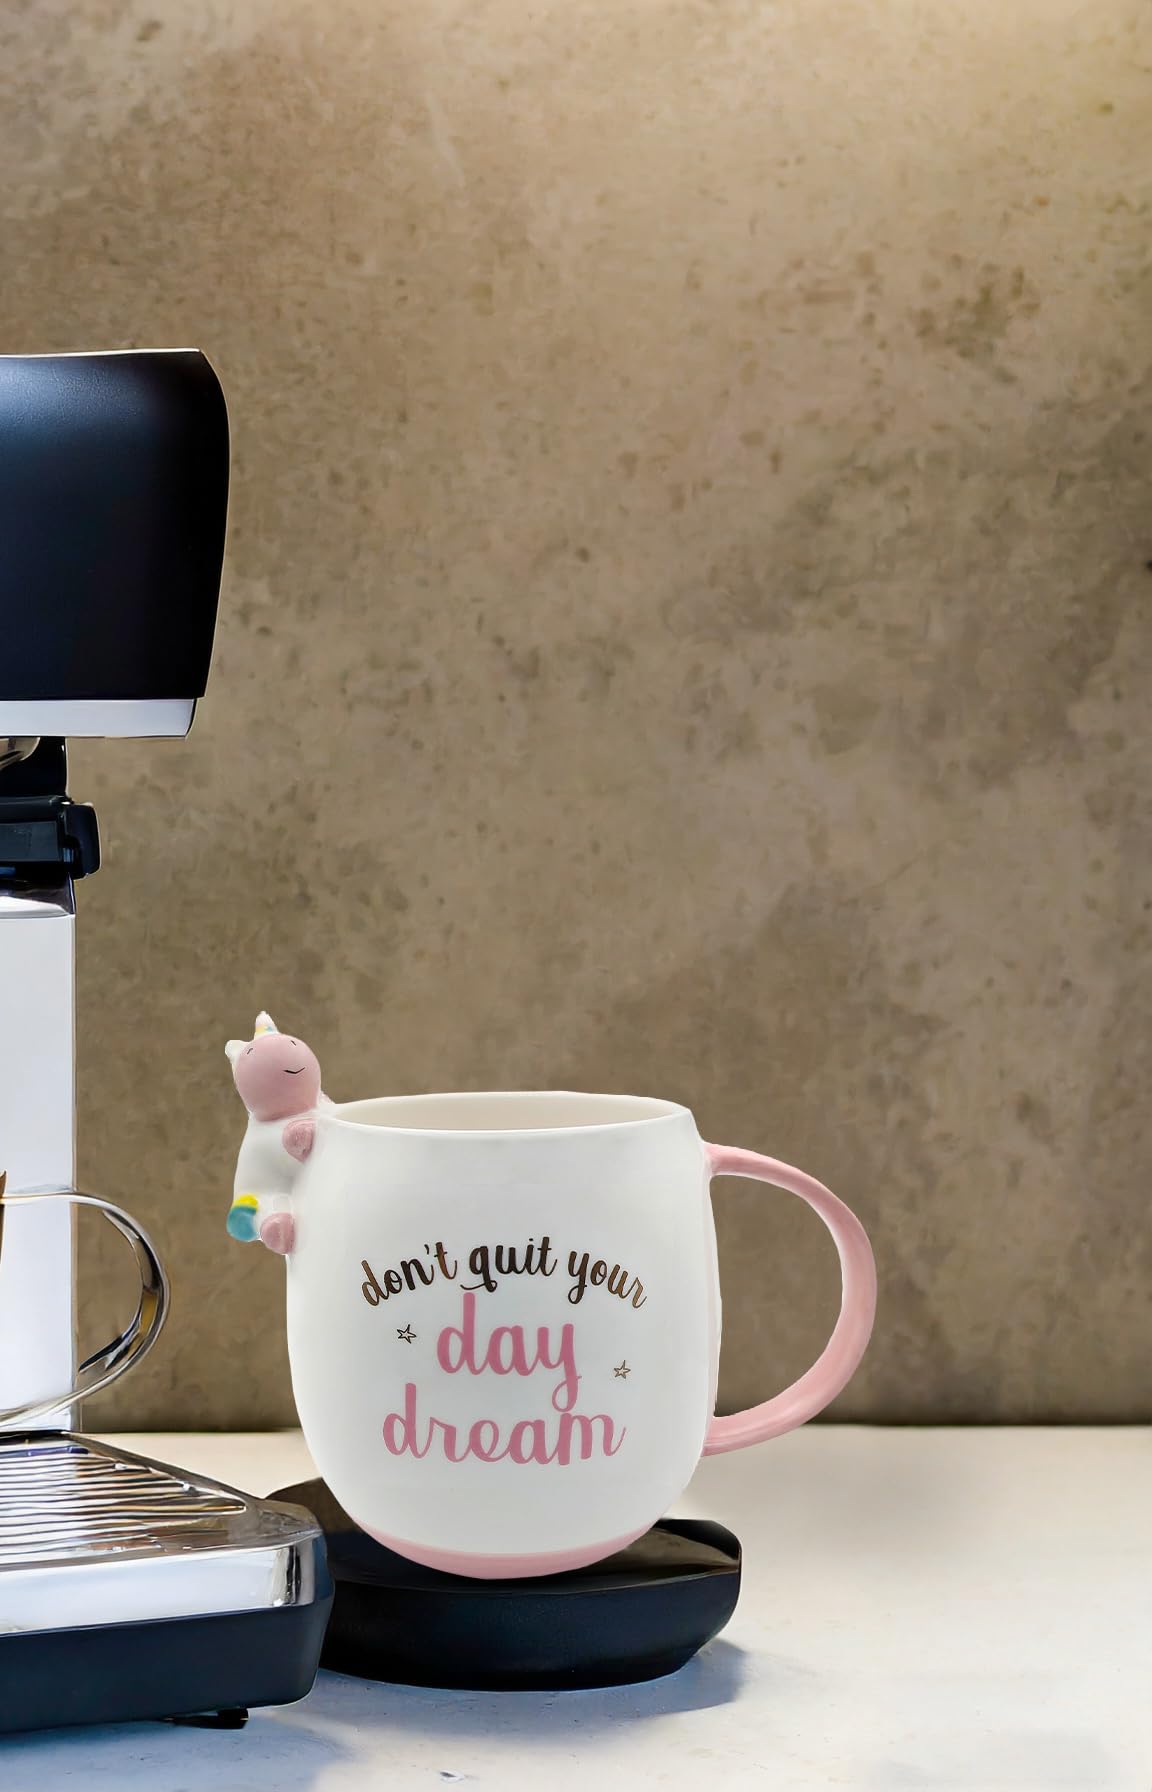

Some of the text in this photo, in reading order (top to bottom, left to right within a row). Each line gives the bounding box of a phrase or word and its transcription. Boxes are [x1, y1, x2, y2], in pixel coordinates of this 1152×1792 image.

[361, 1236, 648, 1309] don't quit your
[436, 1292, 583, 1413] day
[382, 1382, 627, 1466] dream
